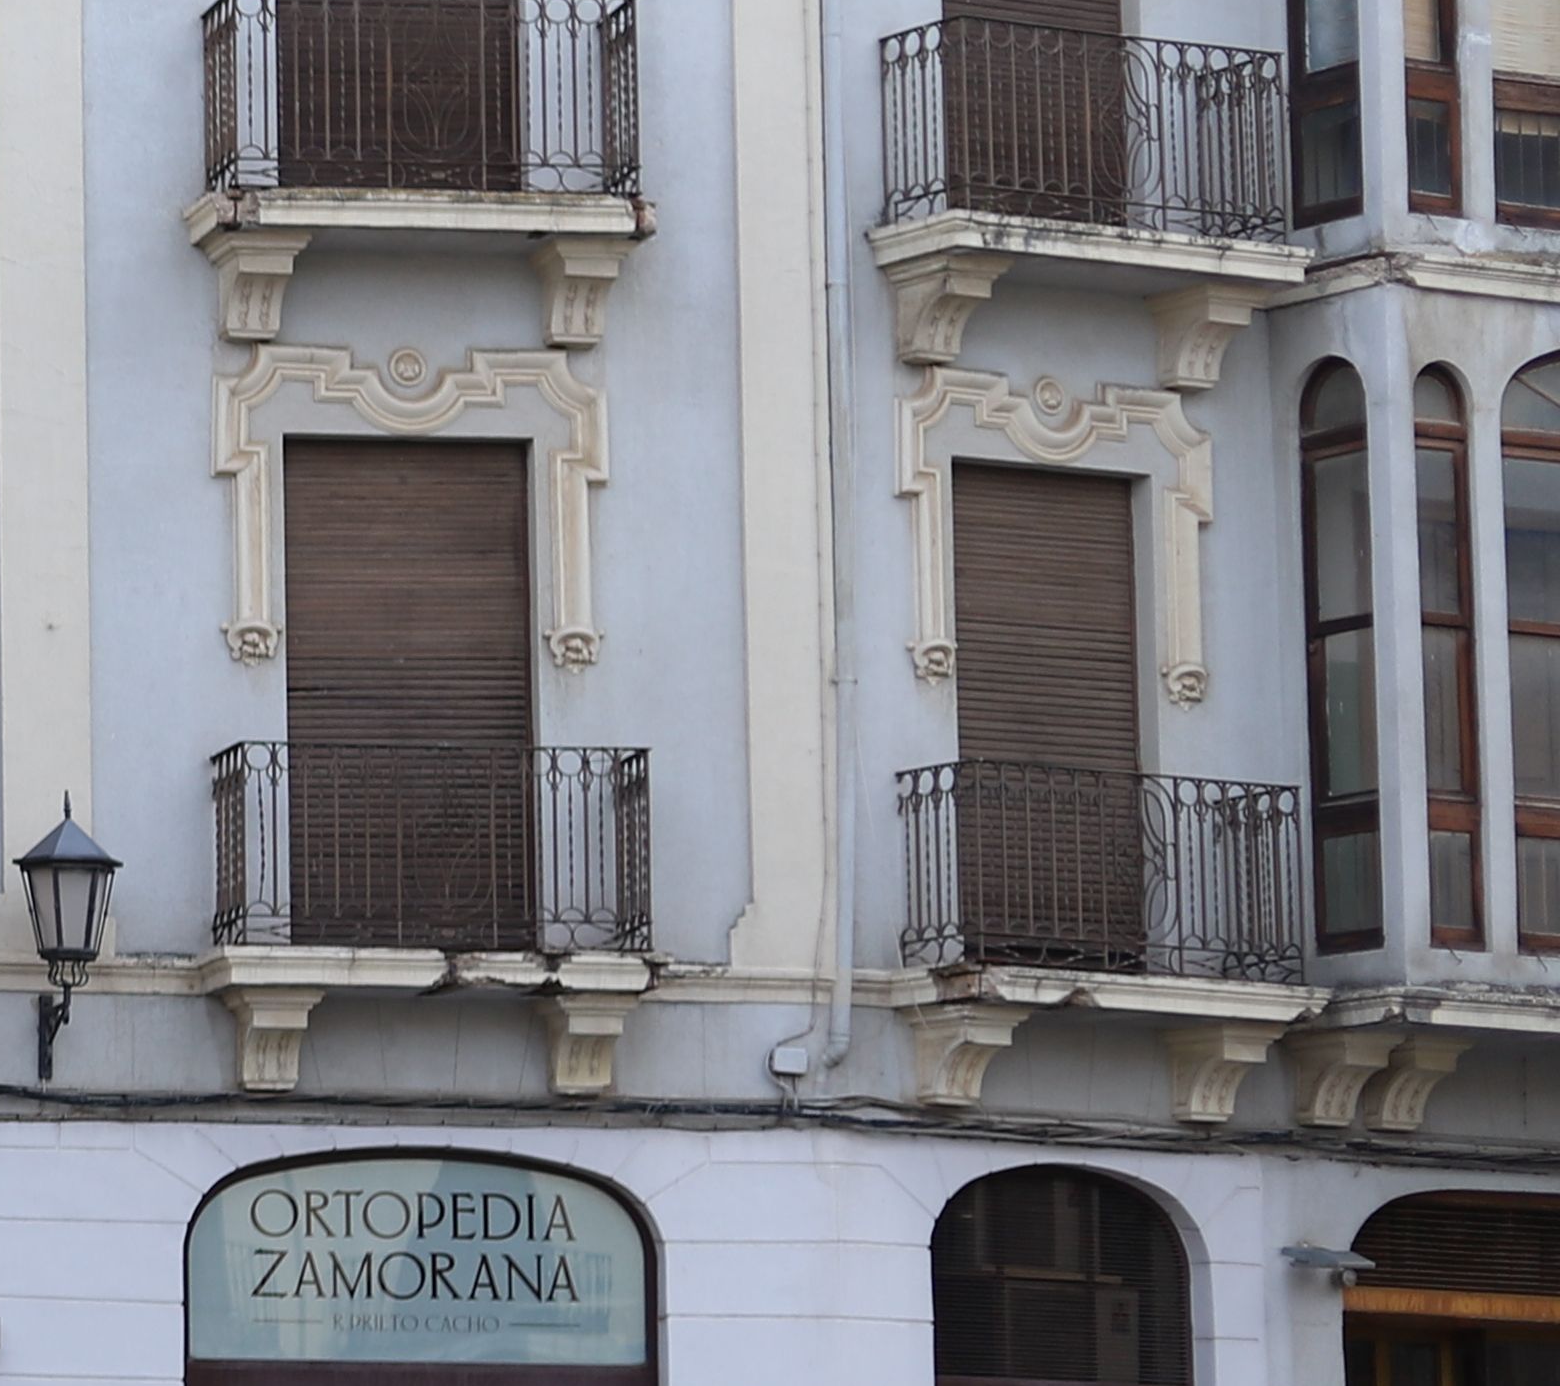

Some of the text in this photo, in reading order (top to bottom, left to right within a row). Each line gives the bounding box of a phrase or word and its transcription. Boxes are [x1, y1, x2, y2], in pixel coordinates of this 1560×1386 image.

[250, 1188, 577, 1242] ORTOPEDIA
[250, 1247, 582, 1302] ZAMORANA
[424, 1315, 501, 1333] CACHO
